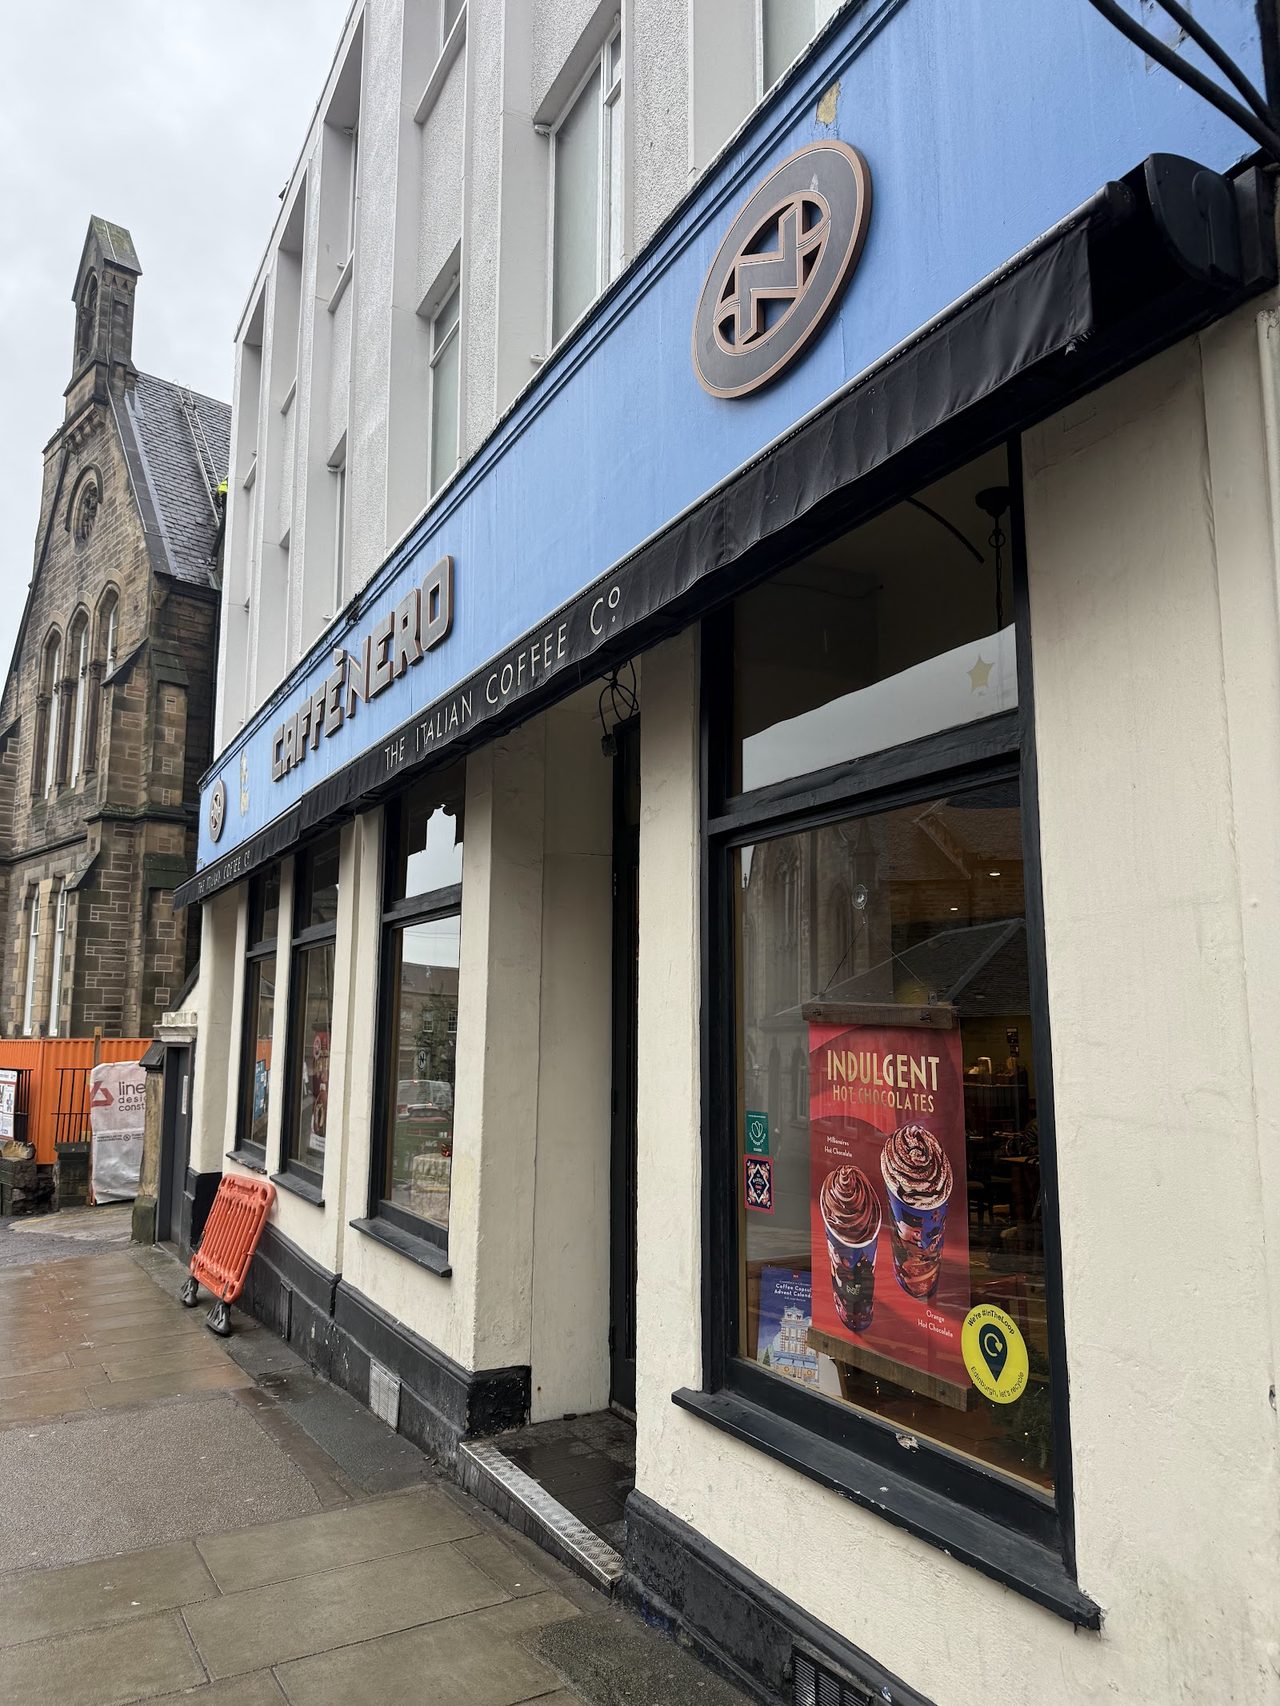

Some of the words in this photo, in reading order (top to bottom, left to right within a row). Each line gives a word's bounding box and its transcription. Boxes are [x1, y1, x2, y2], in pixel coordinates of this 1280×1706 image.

[385, 736, 406, 771] THE
[416, 690, 473, 752] ITALIAN
[485, 622, 567, 704] COFFEE
[827, 1049, 940, 1091] INDULGENT
[833, 1084, 854, 1104] HOT
[858, 1086, 935, 1113] CHOCOLATES
[824, 1145, 832, 1154] Hot
[832, 1147, 853, 1158] Chocolate
[917, 1318, 928, 1329] Hot
[928, 1322, 954, 1338] Chocolate
[926, 1309, 945, 1324] Orange
[967, 1311, 982, 1327] We're
[999, 1389, 1011, 1398] let's
[1010, 1371, 1025, 1396] recycle
